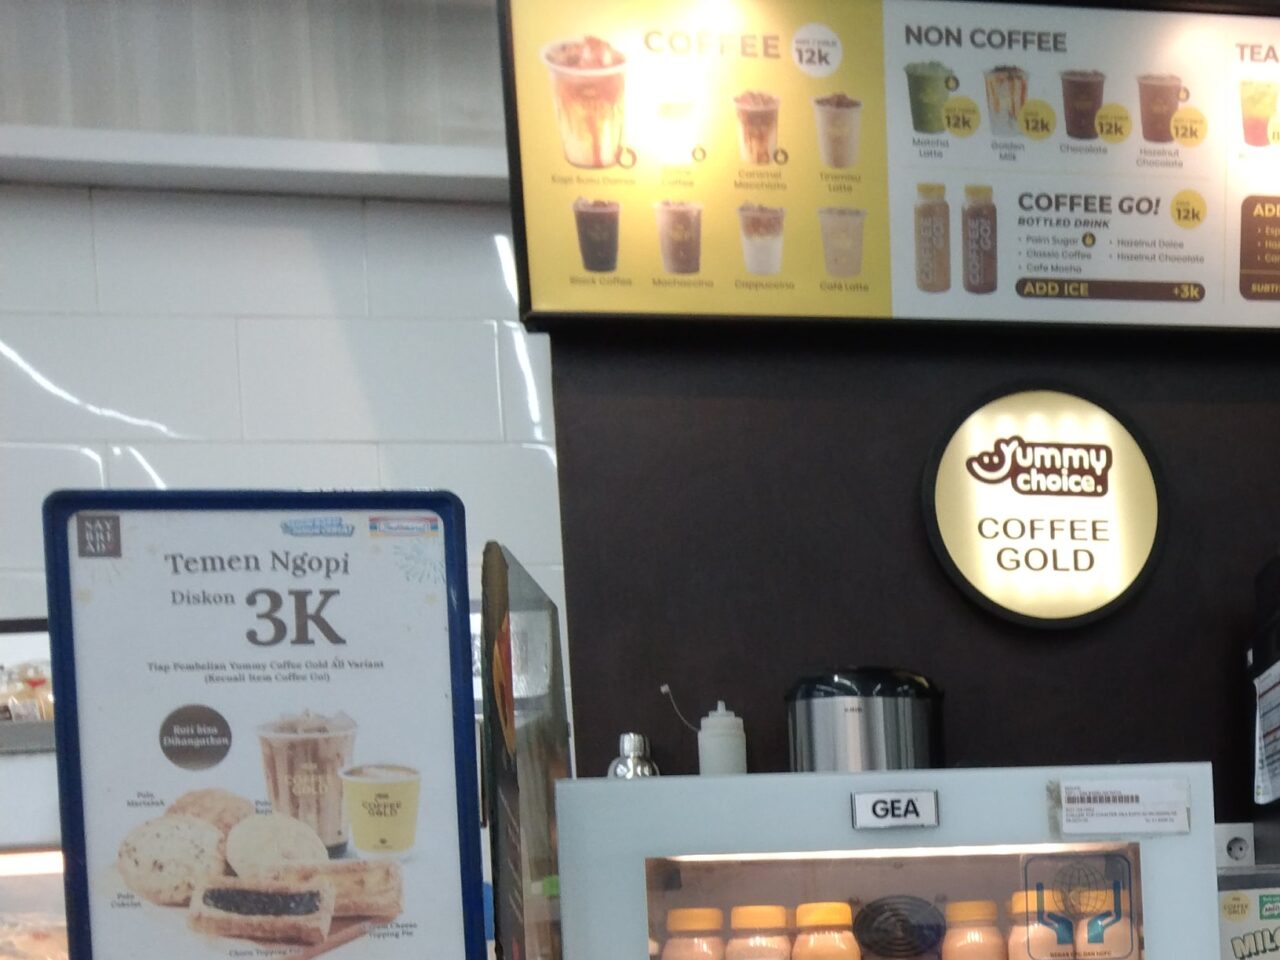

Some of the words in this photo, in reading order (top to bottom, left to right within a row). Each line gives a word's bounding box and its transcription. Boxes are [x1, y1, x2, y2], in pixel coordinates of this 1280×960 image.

[904, 24, 962, 47] NON
[969, 28, 1069, 52] COFFEE
[795, 49, 831, 66] 12k
[1236, 43, 1279, 64] TEA
[945, 114, 972, 129] 12k
[1024, 118, 1050, 132] 12k
[1098, 120, 1124, 134] 12k
[1174, 125, 1199, 139] 12k
[1018, 192, 1113, 215] COFFEE
[1118, 196, 1161, 216] GO!
[1175, 207, 1201, 222] 12k
[1017, 217, 1072, 228] BOTTLED
[1074, 218, 1110, 229] DRINK
[1023, 283, 1060, 297] ADD
[1063, 283, 1090, 297] ICE
[1172, 284, 1201, 299] +3k
[977, 517, 1110, 541] COFFEE
[164, 552, 260, 576] Temen
[269, 550, 351, 579] Ngopi
[996, 547, 1096, 572] GOLD
[171, 589, 236, 606] Diskon
[245, 587, 347, 647] 3K
[172, 661, 227, 672] Pembelian
[229, 661, 267, 673] Yummy
[269, 660, 303, 671] Coffee
[304, 660, 329, 670] Gold
[347, 659, 385, 669] Variant
[274, 672, 308, 683] Coffee
[172, 724, 196, 736] Roti
[162, 735, 230, 750] Dihangatkan
[870, 799, 921, 820] GEA
